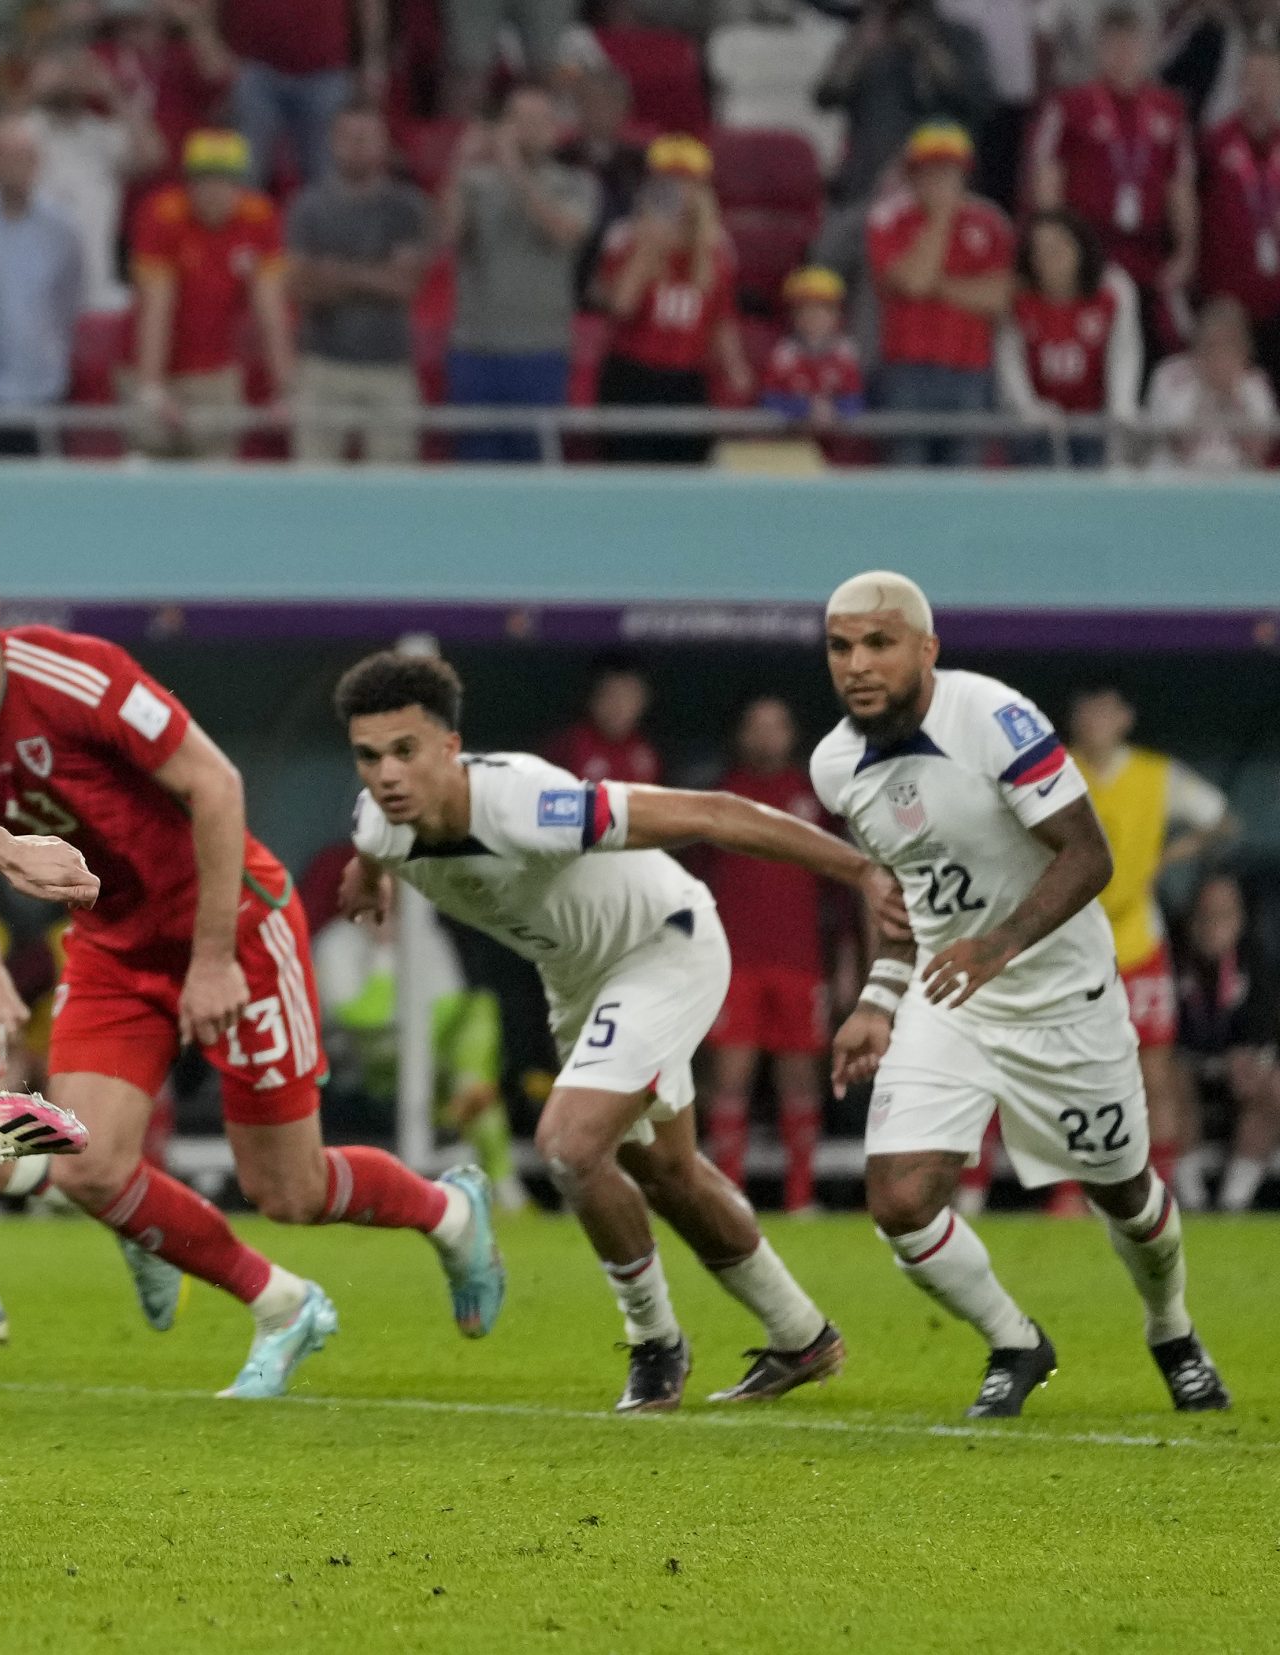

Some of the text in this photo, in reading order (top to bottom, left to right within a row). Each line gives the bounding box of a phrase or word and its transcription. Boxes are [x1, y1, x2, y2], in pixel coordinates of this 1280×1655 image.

[917, 863, 986, 916] 22
[227, 996, 288, 1066] 13
[587, 1002, 621, 1048] 5
[1059, 1103, 1130, 1152] 22
